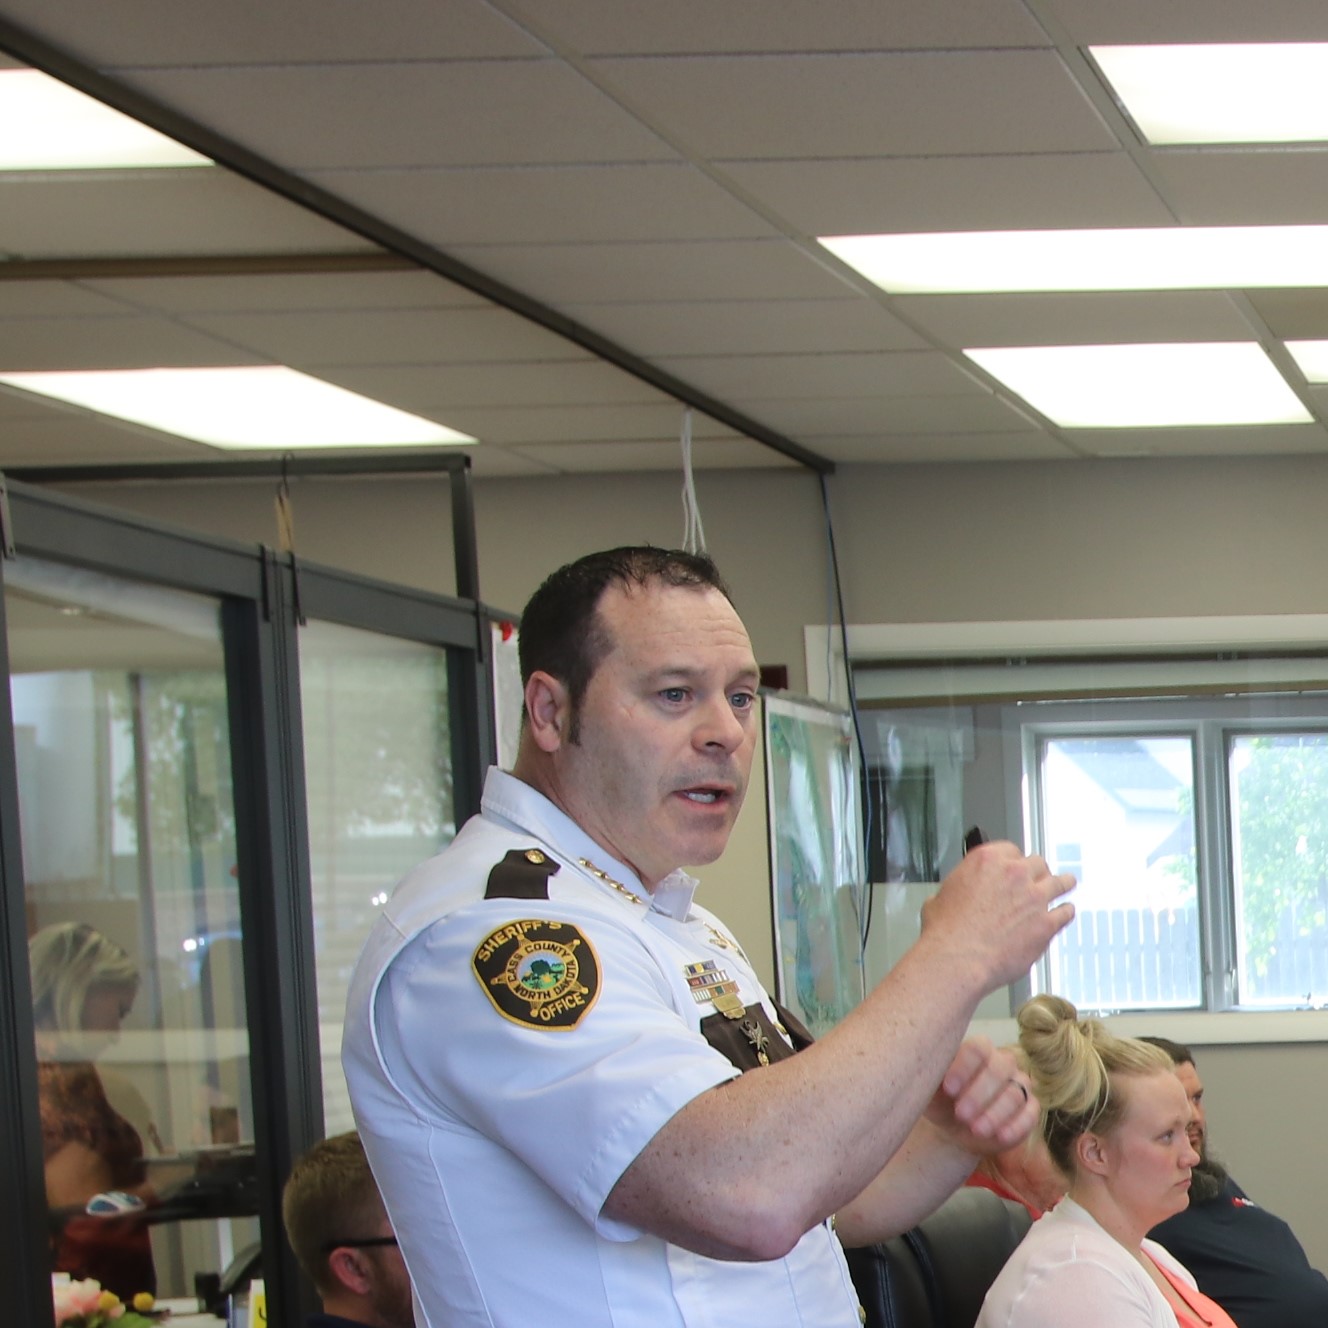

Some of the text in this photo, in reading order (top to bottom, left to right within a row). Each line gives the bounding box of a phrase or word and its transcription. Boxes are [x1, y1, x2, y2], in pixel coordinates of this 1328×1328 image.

[478, 920, 562, 962] SHERIFF'S
[508, 942, 570, 982] CASS COUNTY
[515, 960, 577, 1000] NORTH DAKOTA
[540, 992, 585, 1021] OFFICE
